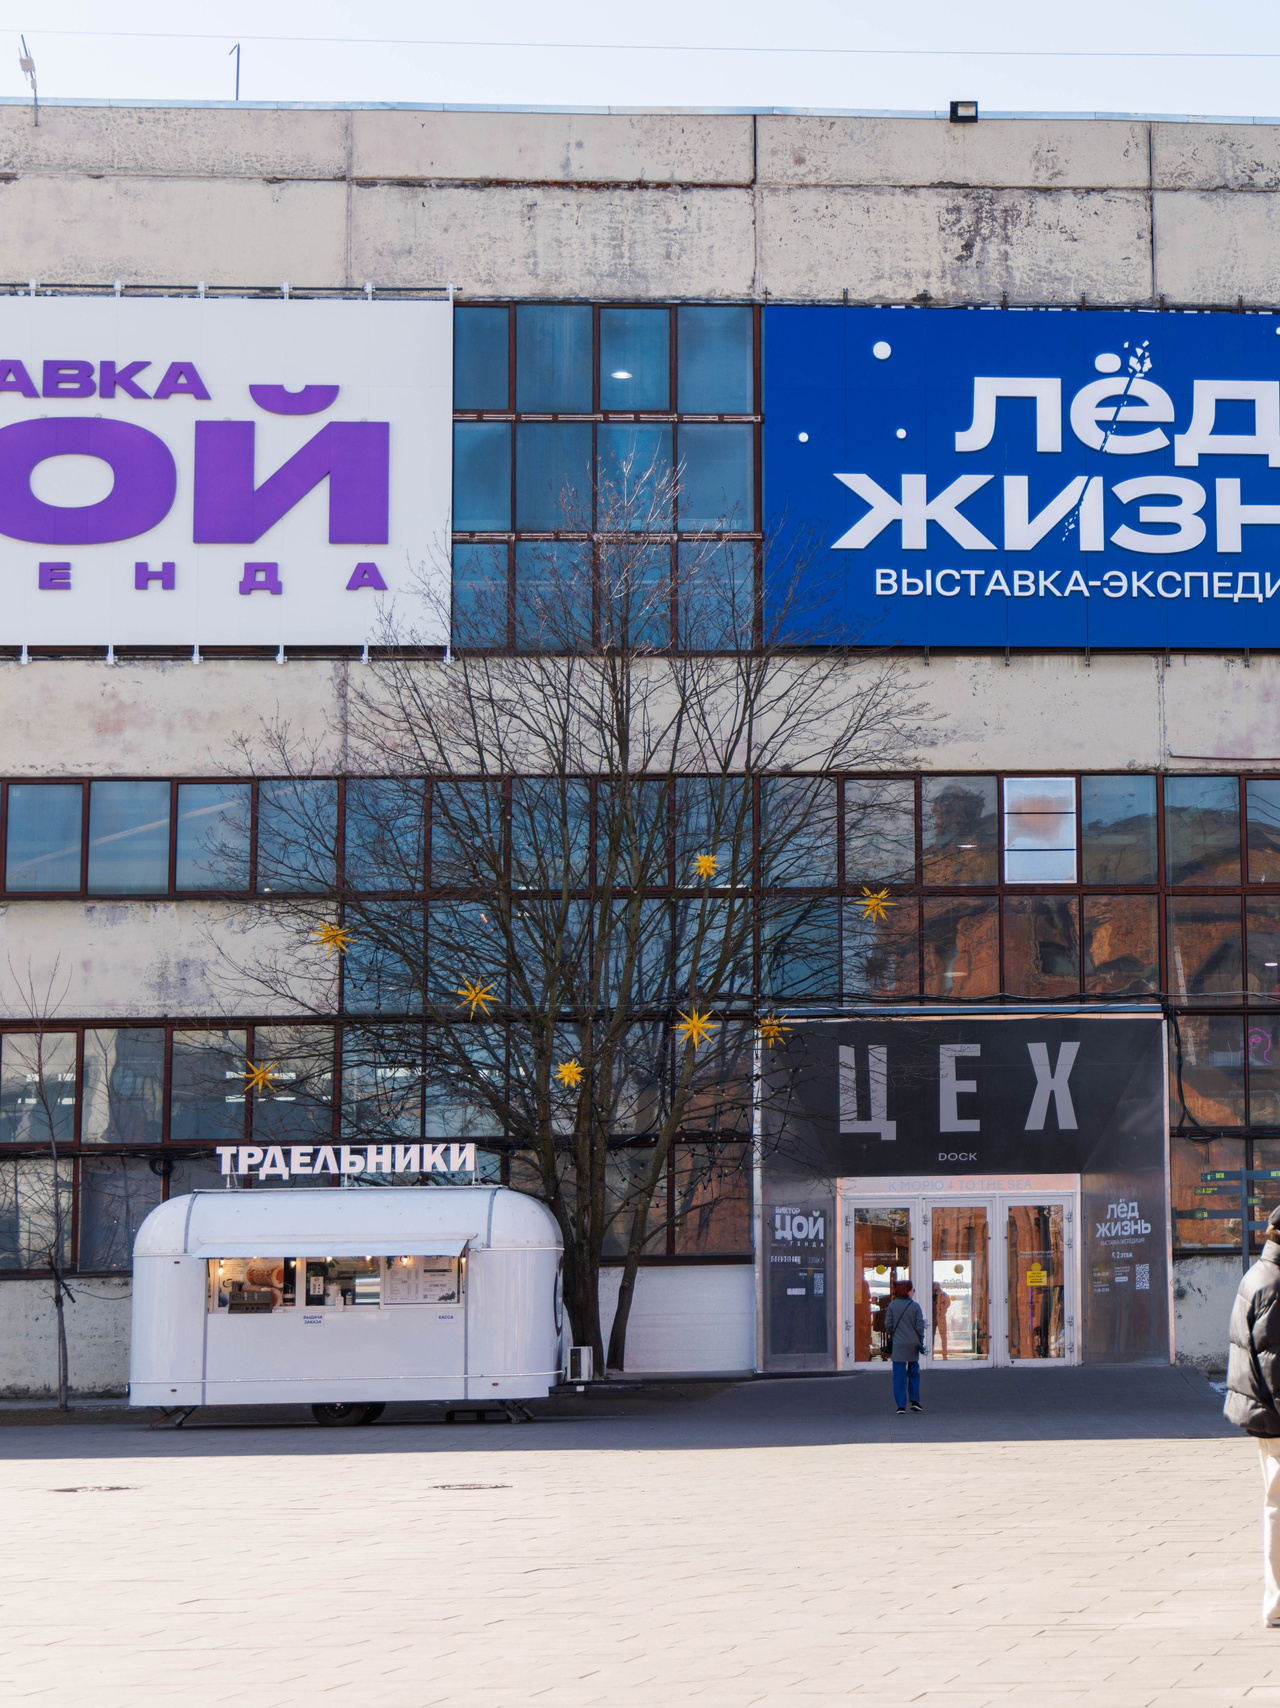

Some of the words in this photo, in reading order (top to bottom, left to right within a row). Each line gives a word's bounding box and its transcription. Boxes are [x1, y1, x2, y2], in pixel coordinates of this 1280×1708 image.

[0, 384, 390, 546] ОЙ
[838, 1041, 1081, 1141] ЦЕХ
[216, 1143, 476, 1180] ТРДЕЛЬНИКИ
[938, 1152, 978, 1161] DOCK
[888, 1180, 897, 1191] К
[899, 1180, 945, 1191] МОРЮ
[958, 1179, 976, 1190] TO
[979, 1179, 1005, 1190] THE
[1007, 1179, 1033, 1190] SEA
[775, 1206, 801, 1214] ВИКТОР
[775, 1210, 825, 1241] ЦОЙ
